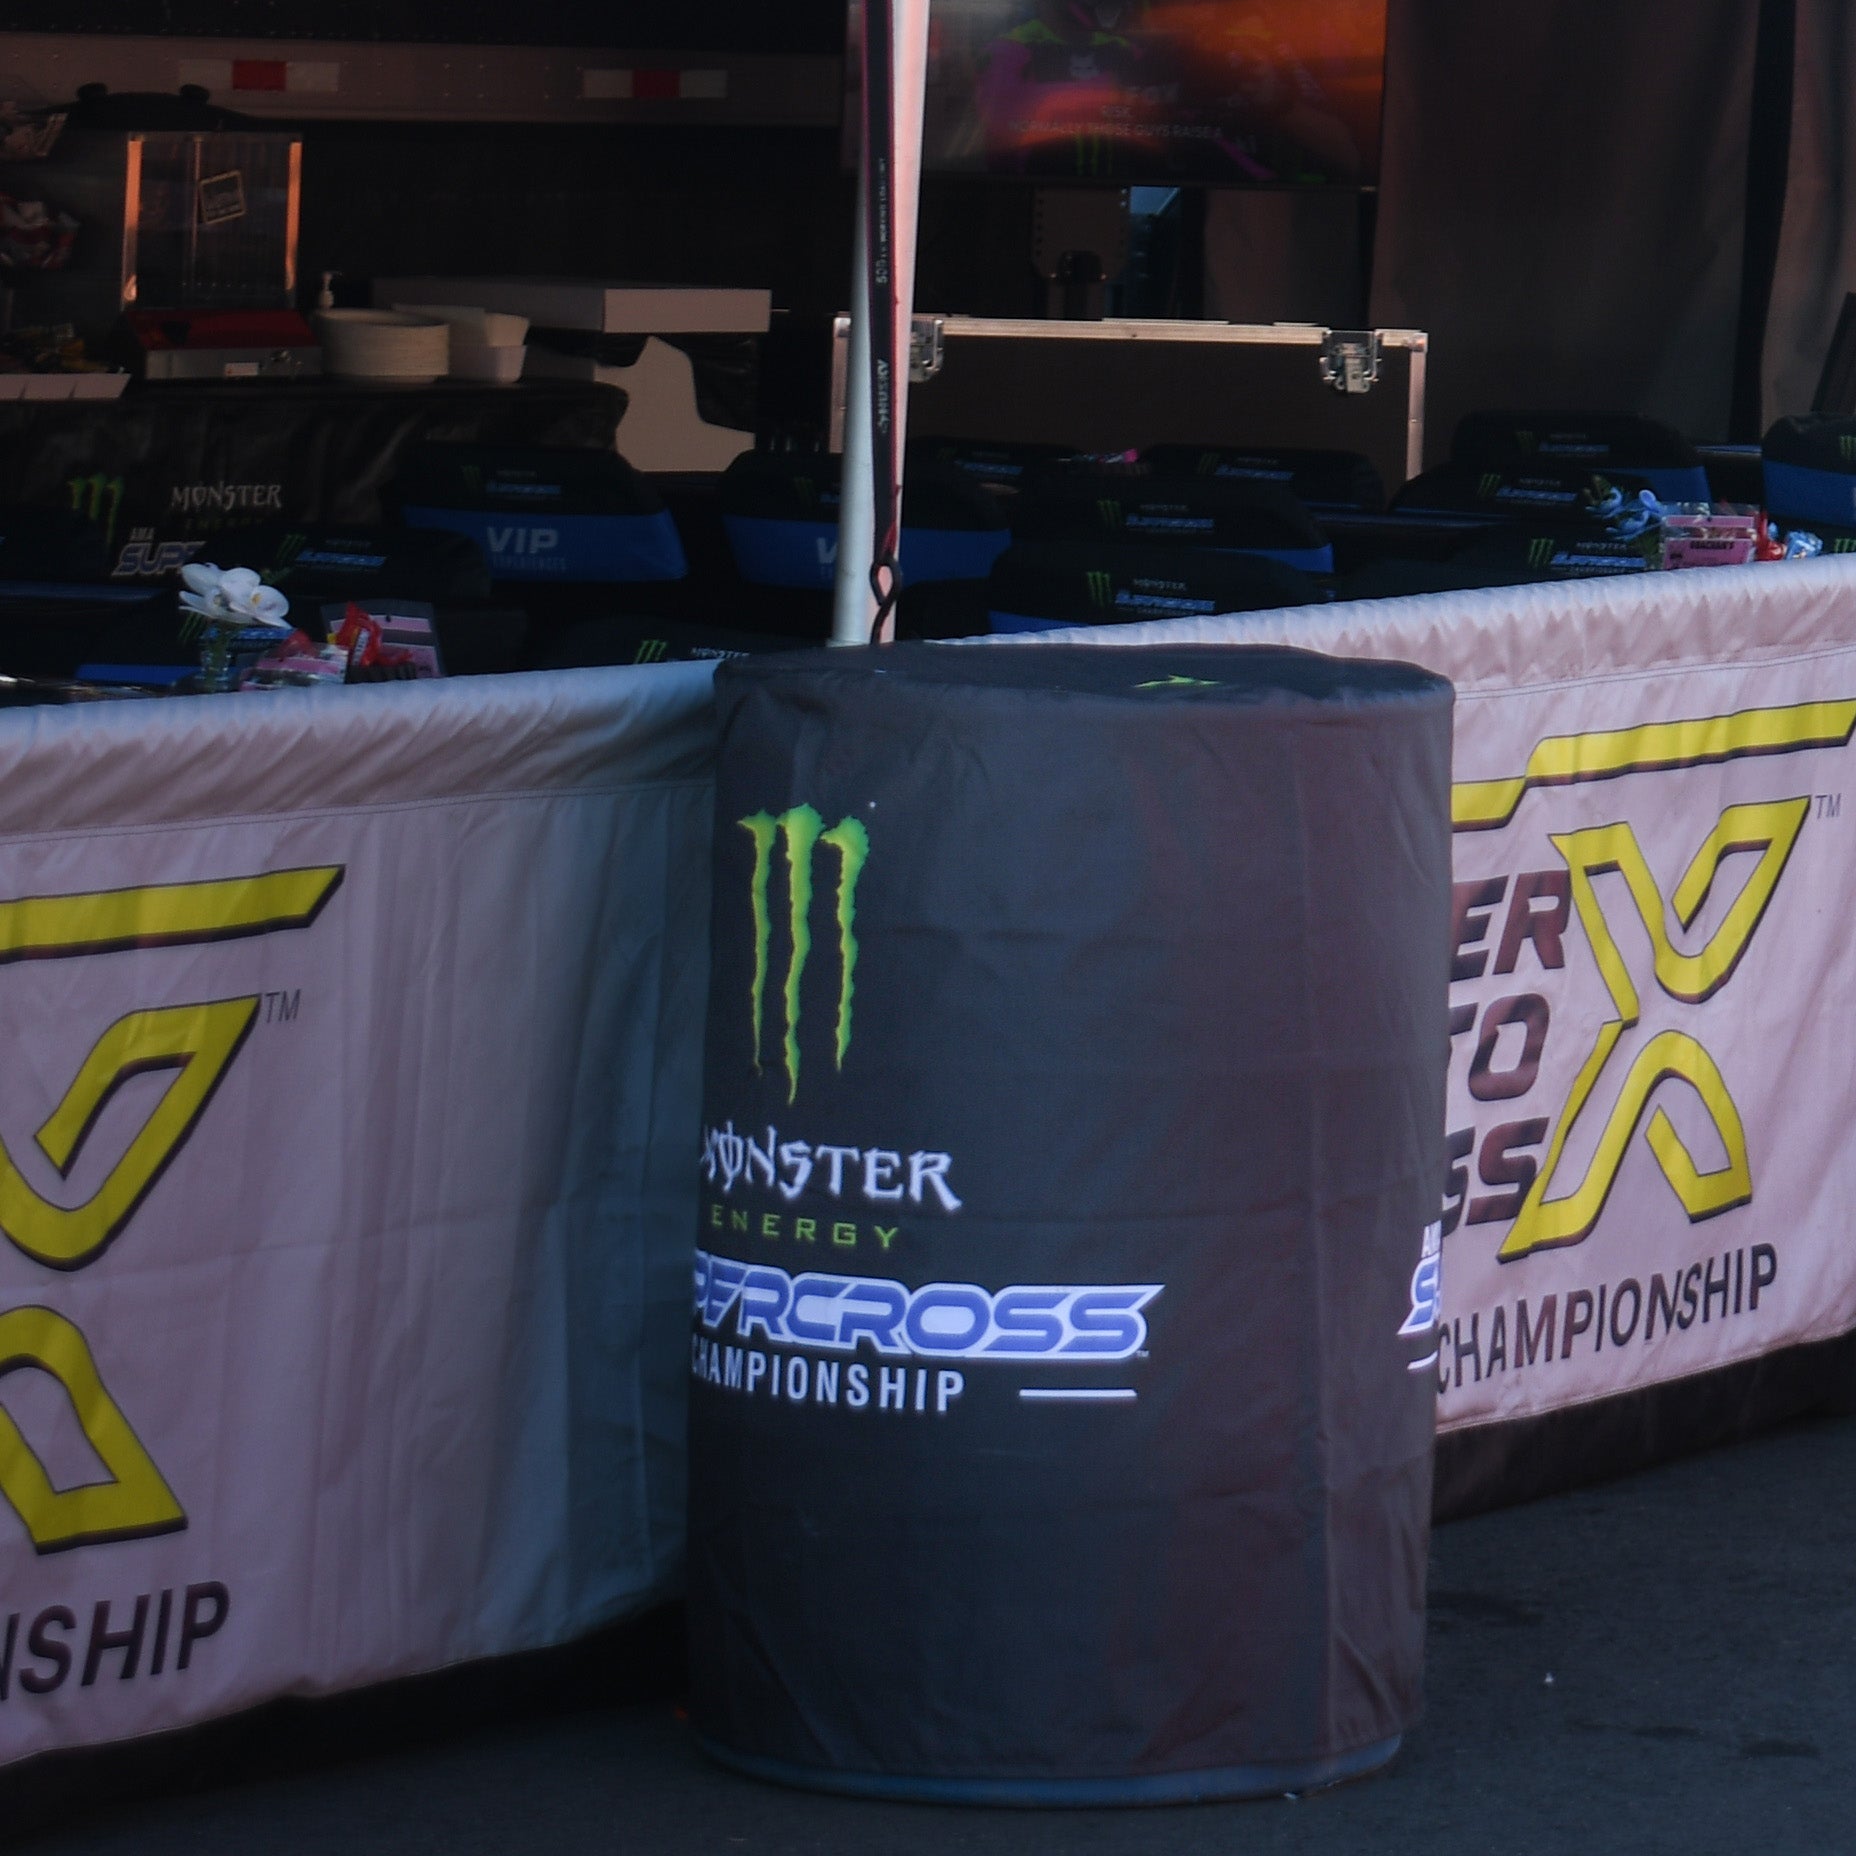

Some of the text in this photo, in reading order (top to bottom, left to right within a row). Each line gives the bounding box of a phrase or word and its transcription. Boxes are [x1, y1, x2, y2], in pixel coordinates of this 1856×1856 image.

[876, 358, 889, 415] HUSKY
[170, 480, 282, 511] MONSTER
[485, 526, 559, 554] VIP
[711, 1203, 899, 1250] ENERGY
[1435, 1242, 1778, 1396] CHAMPIONSHIP
